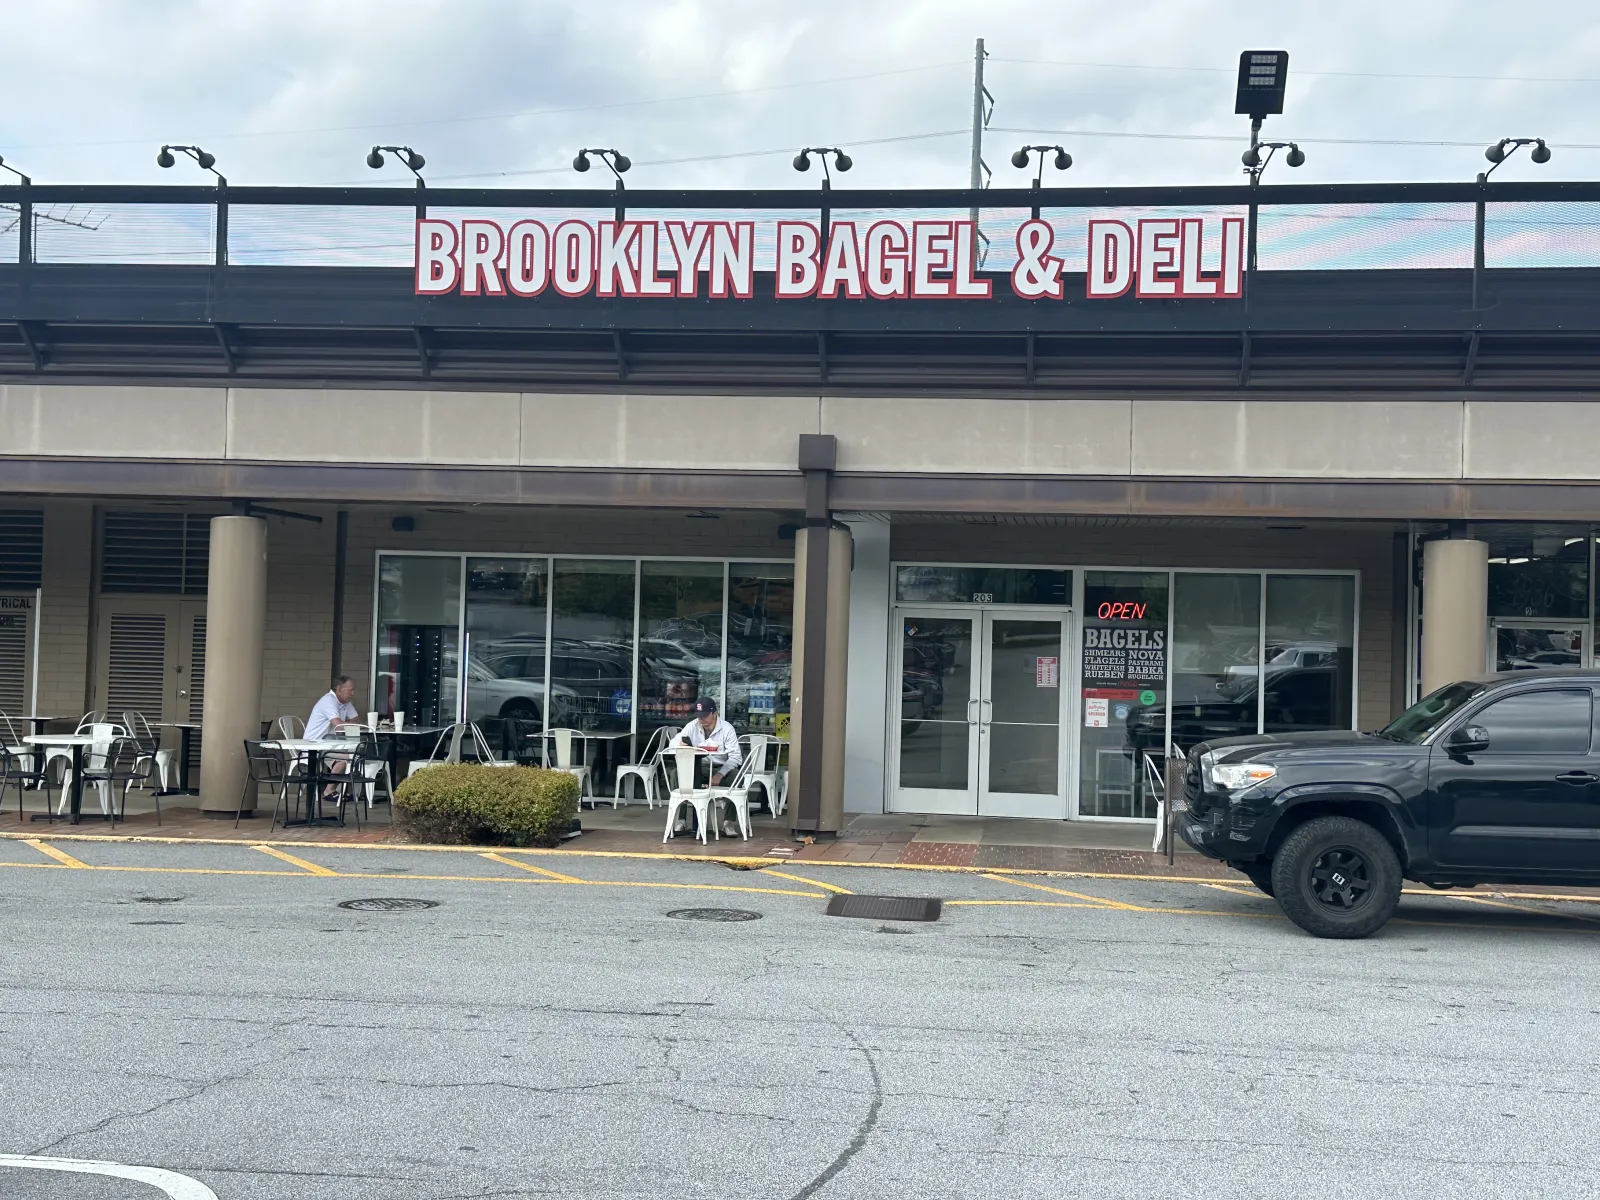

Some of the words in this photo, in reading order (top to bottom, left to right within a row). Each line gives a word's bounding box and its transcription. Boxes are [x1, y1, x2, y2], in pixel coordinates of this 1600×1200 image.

[415, 219, 753, 298] BROOKLYN
[775, 219, 992, 299] BAGEL
[1011, 218, 1064, 299] &
[1086, 218, 1244, 298] DELI
[974, 593, 992, 602] 203
[0, 598, 32, 609] RICAL
[1098, 602, 1147, 619] OPEN
[1085, 628, 1164, 649] BAGELS
[1084, 649, 1126, 657] SHMEARS
[1128, 650, 1164, 660] NOVA
[1084, 657, 1125, 665] FLAGELS
[1084, 670, 1124, 678] RUEBEN
[1128, 666, 1164, 674] BABKA
